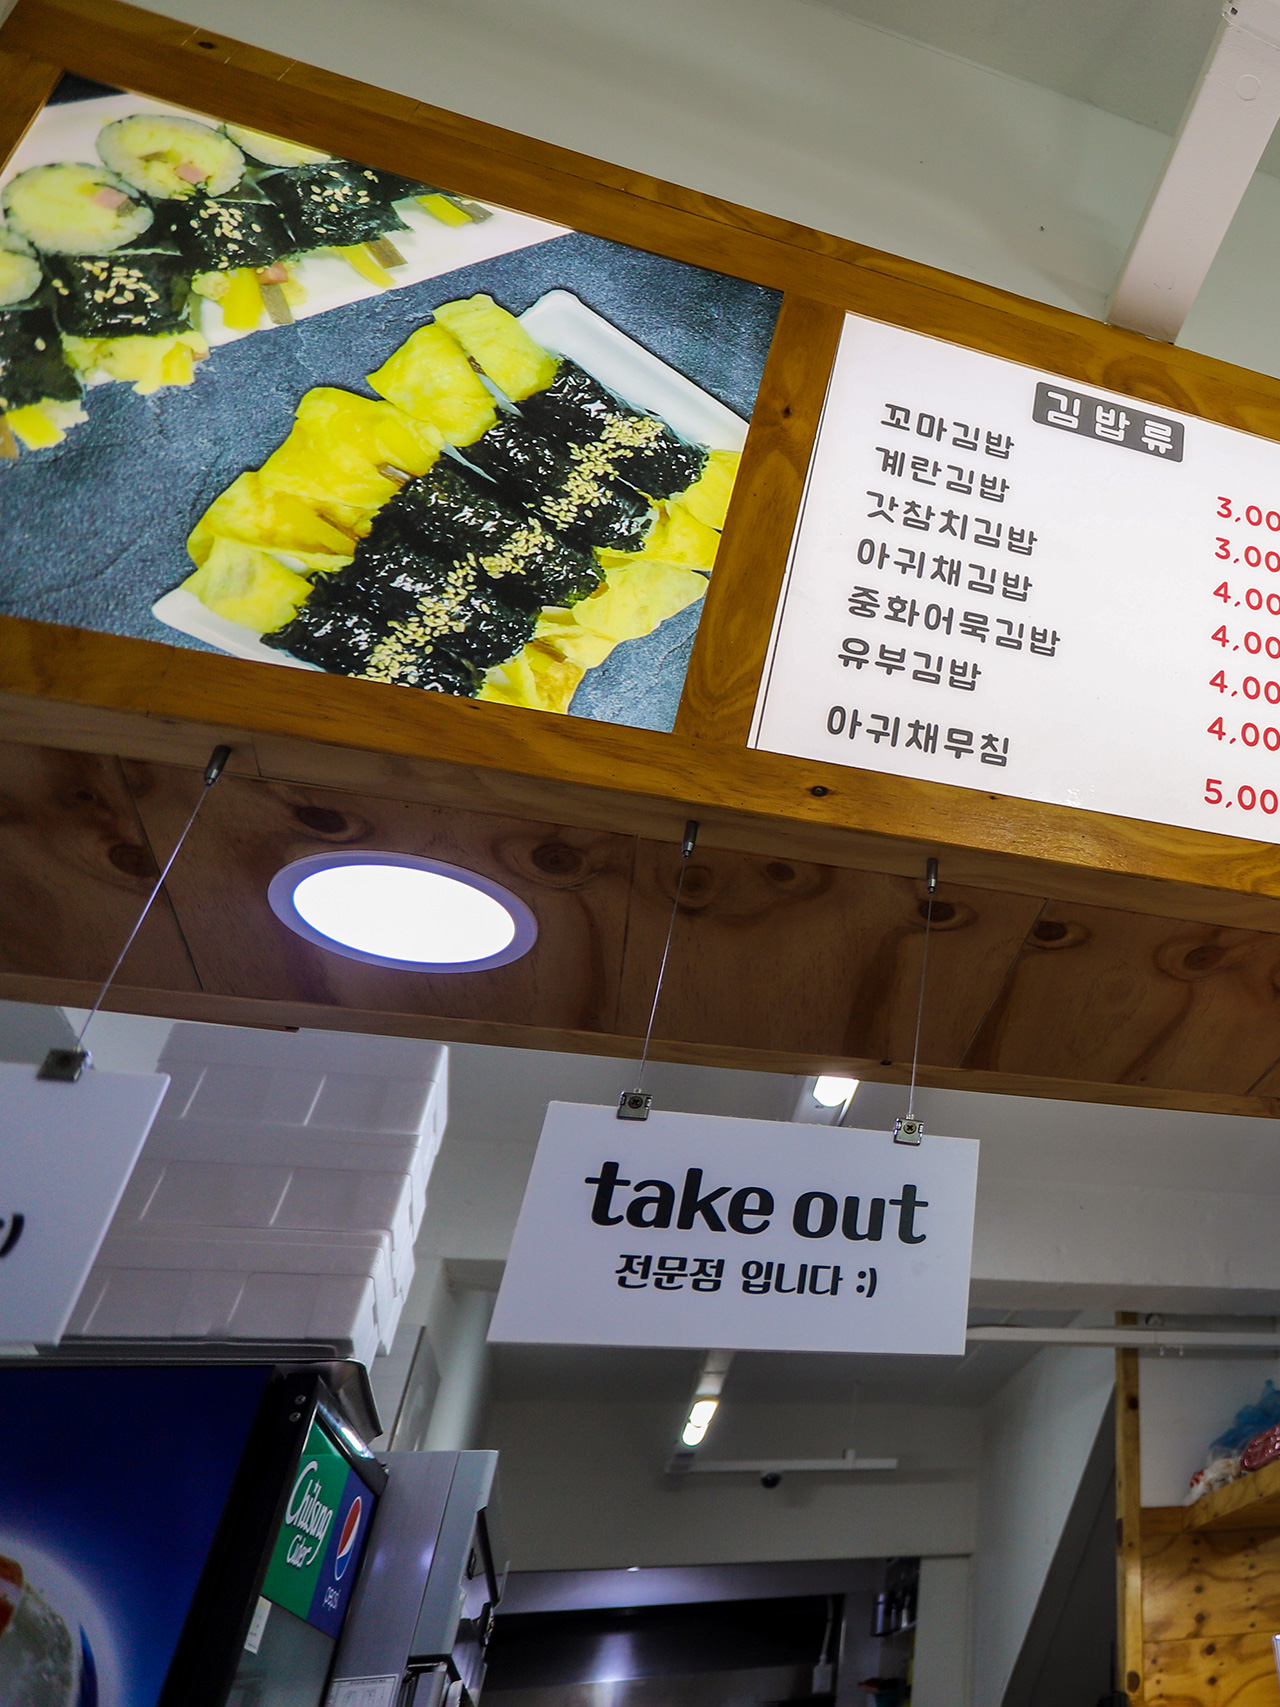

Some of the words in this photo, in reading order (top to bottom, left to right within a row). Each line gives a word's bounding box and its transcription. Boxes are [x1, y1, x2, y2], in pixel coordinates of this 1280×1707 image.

[880, 403, 1015, 460] 꼬마김밥
[1047, 391, 1172, 455] 김밥류
[876, 448, 1010, 503] 계란김밥
[865, 491, 1037, 556] 갓참치김밥
[857, 537, 1032, 602] 아귀채김밥
[847, 587, 1061, 657] 중화어묵김밥
[837, 638, 981, 691] 유부김밥
[827, 705, 1009, 767] 아귀채무침
[584, 1161, 775, 1235] take
[792, 1184, 929, 1245] out
[615, 1254, 725, 1292] 전문점
[741, 1260, 843, 1296] 입니다
